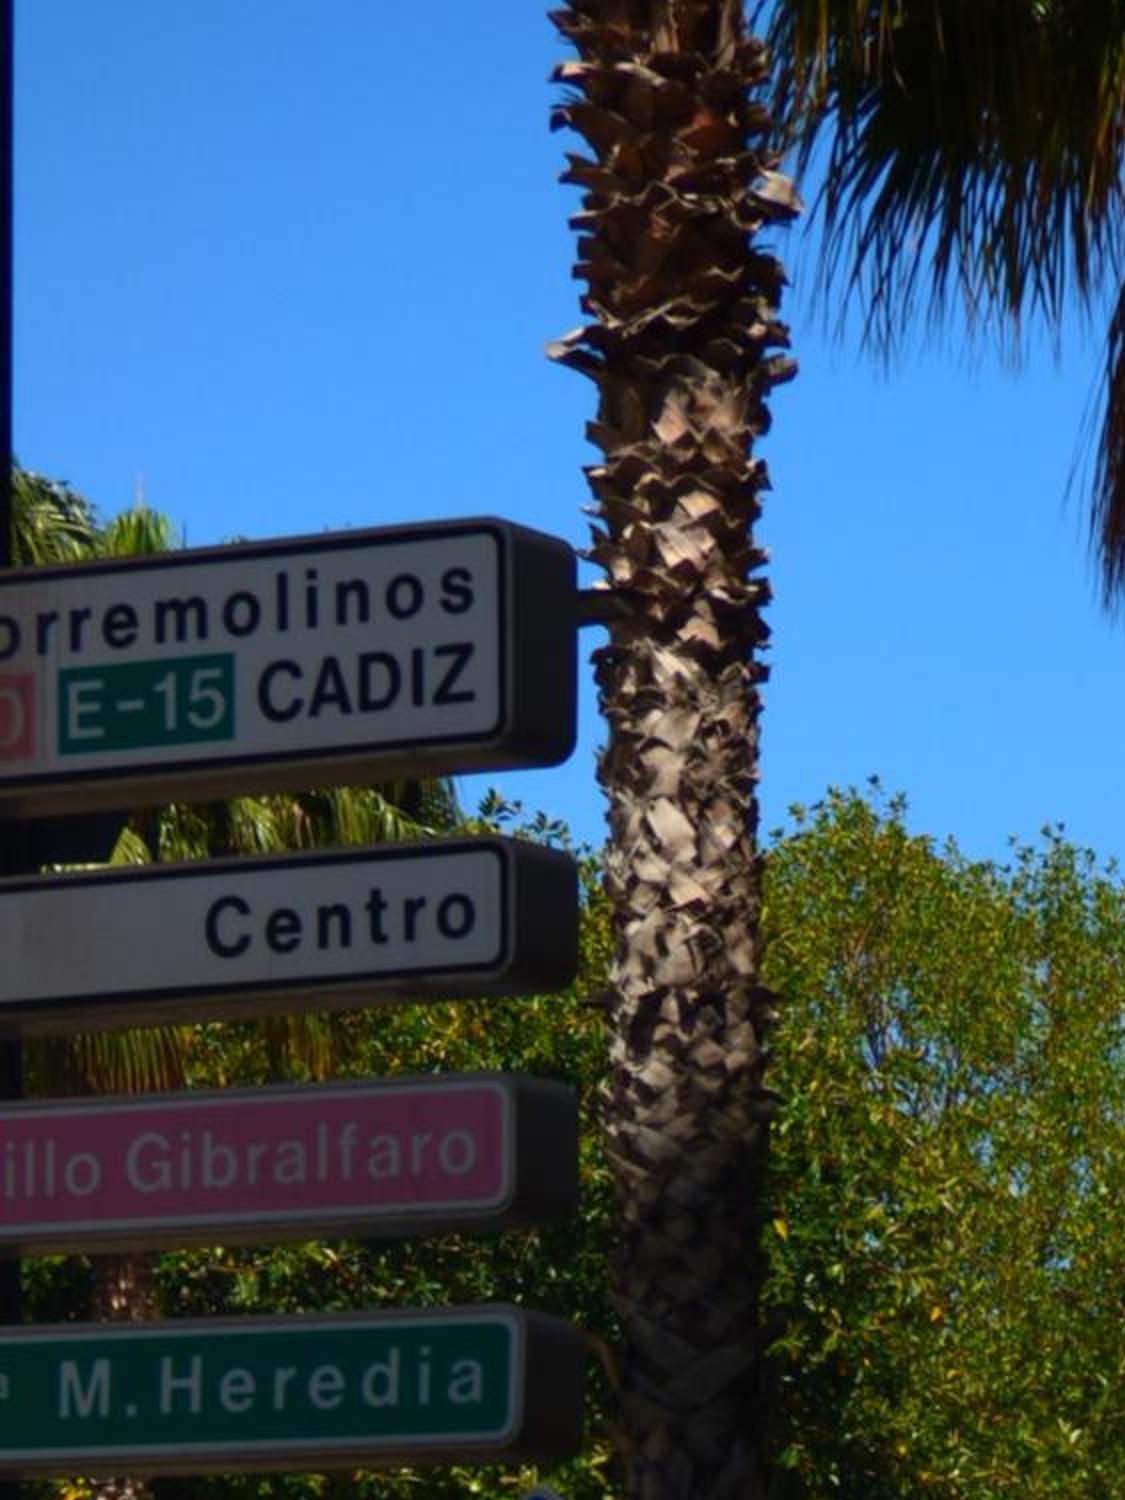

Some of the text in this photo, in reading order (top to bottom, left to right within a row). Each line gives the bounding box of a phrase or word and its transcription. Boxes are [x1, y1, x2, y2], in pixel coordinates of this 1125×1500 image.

[66, 666, 227, 741] E-15
[257, 643, 476, 723] CADIZ
[204, 889, 477, 959] Centro
[126, 1122, 477, 1193] Gibralfaro
